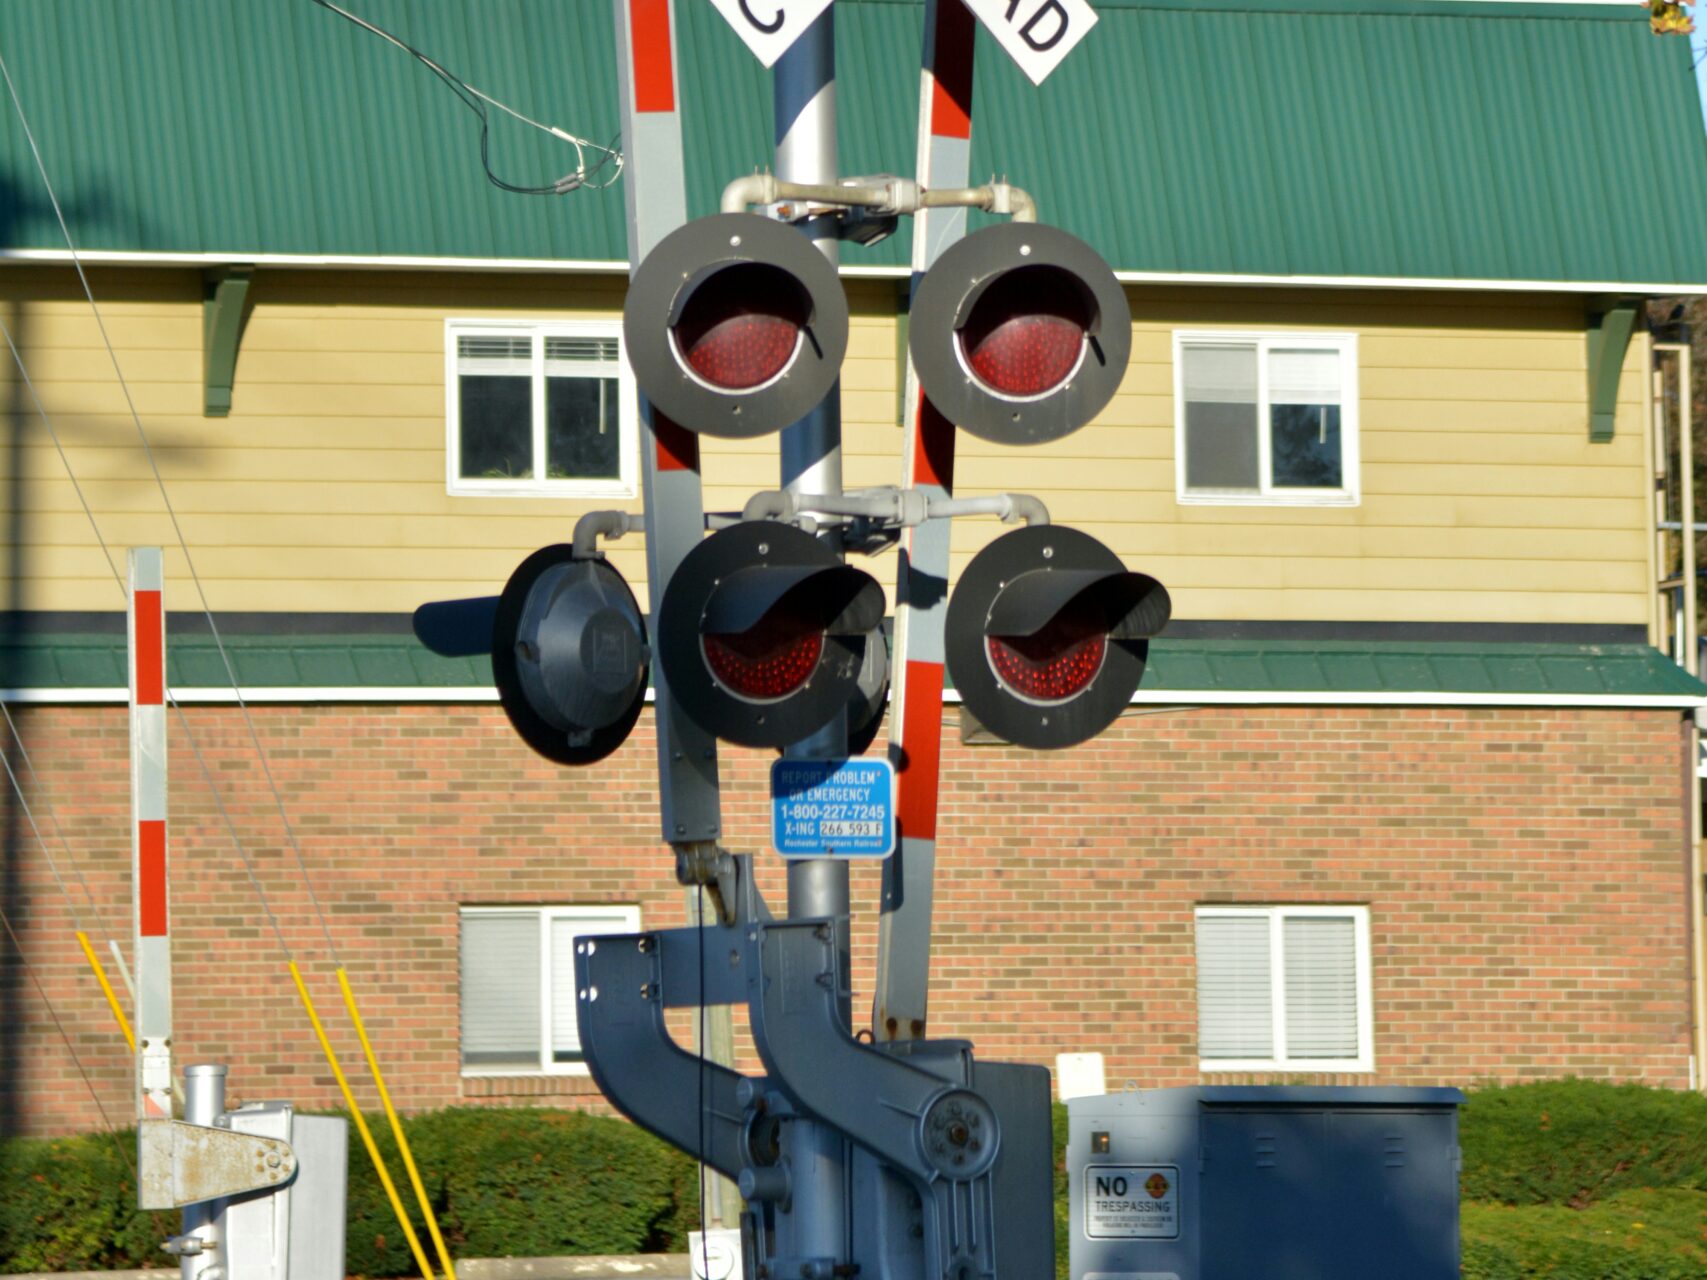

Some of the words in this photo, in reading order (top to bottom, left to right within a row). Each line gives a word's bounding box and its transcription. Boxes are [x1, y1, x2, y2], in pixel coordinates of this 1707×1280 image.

[782, 771, 822, 784] REPORT
[826, 771, 875, 784] PROBLEM
[789, 788, 804, 801] OR
[807, 787, 870, 801] EMERGENCY
[781, 805, 885, 820] 1-800-227-7245
[785, 822, 815, 836] X-ING
[821, 823, 843, 835] 266
[849, 823, 870, 835] 593
[876, 823, 882, 835] F
[1096, 1176, 1128, 1197] NO
[1095, 1201, 1170, 1213] TRESPASSING
